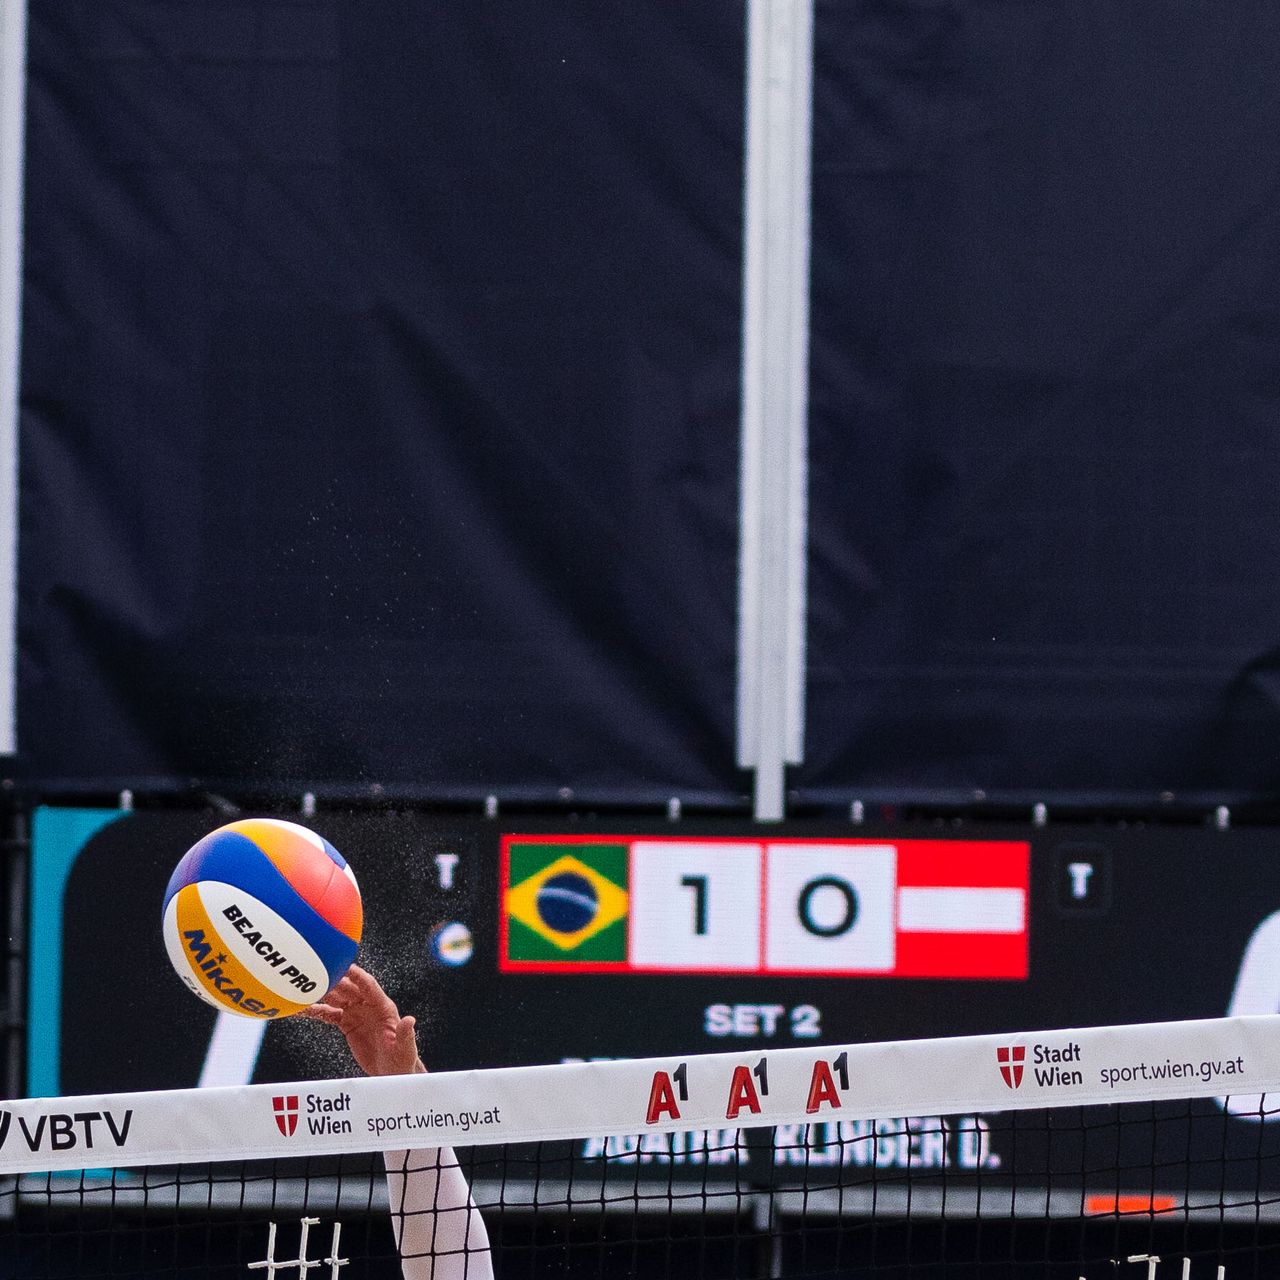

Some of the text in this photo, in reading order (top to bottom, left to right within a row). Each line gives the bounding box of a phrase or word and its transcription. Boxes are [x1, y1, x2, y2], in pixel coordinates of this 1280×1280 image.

[679, 874, 711, 936] 1
[797, 873, 859, 939] 0
[222, 904, 317, 994] BEACH PRO
[703, 1004, 822, 1037] SET 2
[1033, 1042, 1081, 1065] Stadt
[1100, 1056, 1245, 1088] sport.wien.gv.at
[646, 1062, 689, 1125] A1
[726, 1057, 769, 1120] A1
[806, 1051, 850, 1115] A1
[1034, 1067, 1083, 1088] Wien
[306, 1092, 351, 1114] Stadt
[366, 1106, 501, 1137] sport.wien.gv.at
[17, 1109, 134, 1152] VBTV
[307, 1116, 352, 1136] Wien
